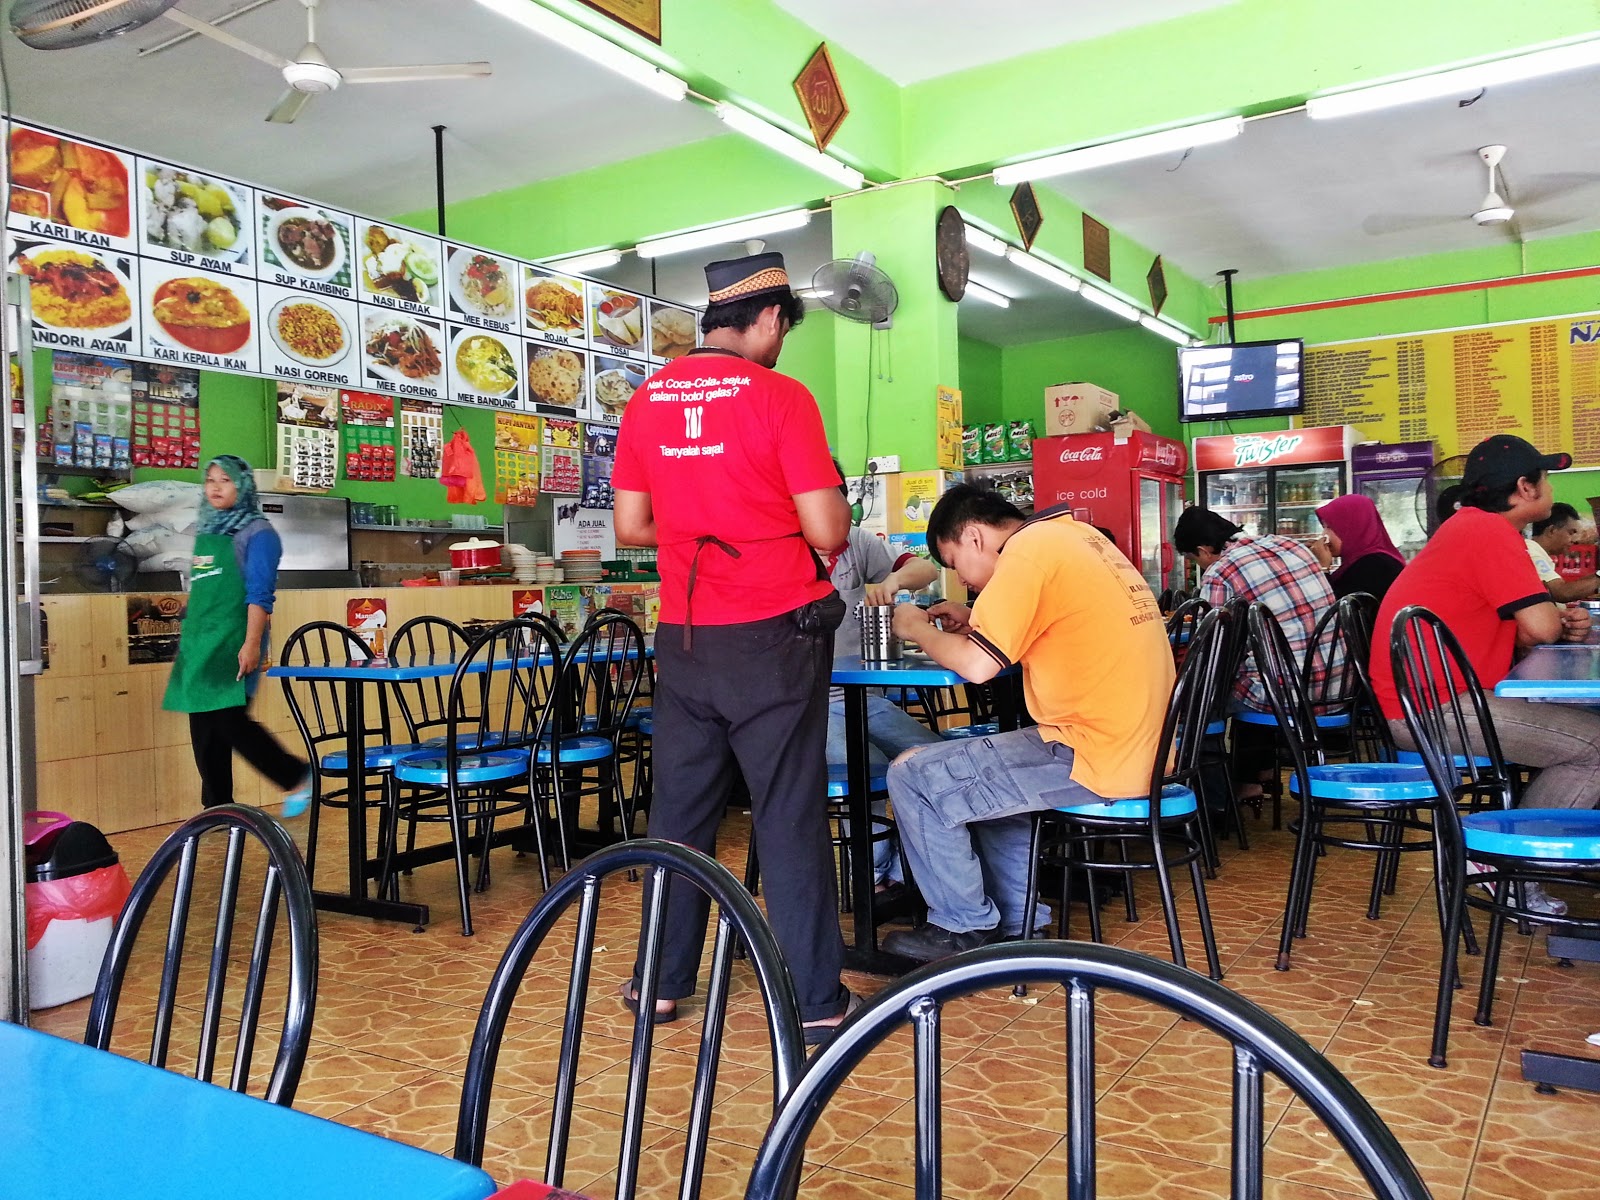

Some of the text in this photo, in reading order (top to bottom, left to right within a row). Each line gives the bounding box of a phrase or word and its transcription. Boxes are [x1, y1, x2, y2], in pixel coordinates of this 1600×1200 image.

[30, 220, 110, 247] KARI IKAN
[170, 250, 232, 272] SUP AYAM
[275, 274, 350, 297] SUP KAMBING
[373, 294, 431, 315] NASI LEMAK
[464, 314, 510, 332] MEE REBUS
[32, 329, 126, 353] ANDORI AYAM
[544, 332, 569, 344] ROJAK
[154, 348, 246, 370] KARI KEPALA IKAN
[610, 346, 629, 356] TOSAI
[275, 365, 348, 384] NASI GORENG
[647, 380, 663, 390] Nak
[722, 375, 751, 386] sejuk
[1233, 373, 1254, 382] astro
[376, 380, 438, 397] MEE GORENG
[650, 387, 740, 402] dalam botol gelas?
[351, 400, 384, 411] RADIX
[458, 393, 516, 408] MEE BANDUNG
[603, 414, 617, 422] ROTI
[659, 445, 700, 459] Tanyalah
[1060, 446, 1103, 463] Coca-Cola
[1235, 437, 1299, 465] Twister
[1056, 488, 1106, 501] ice cold
